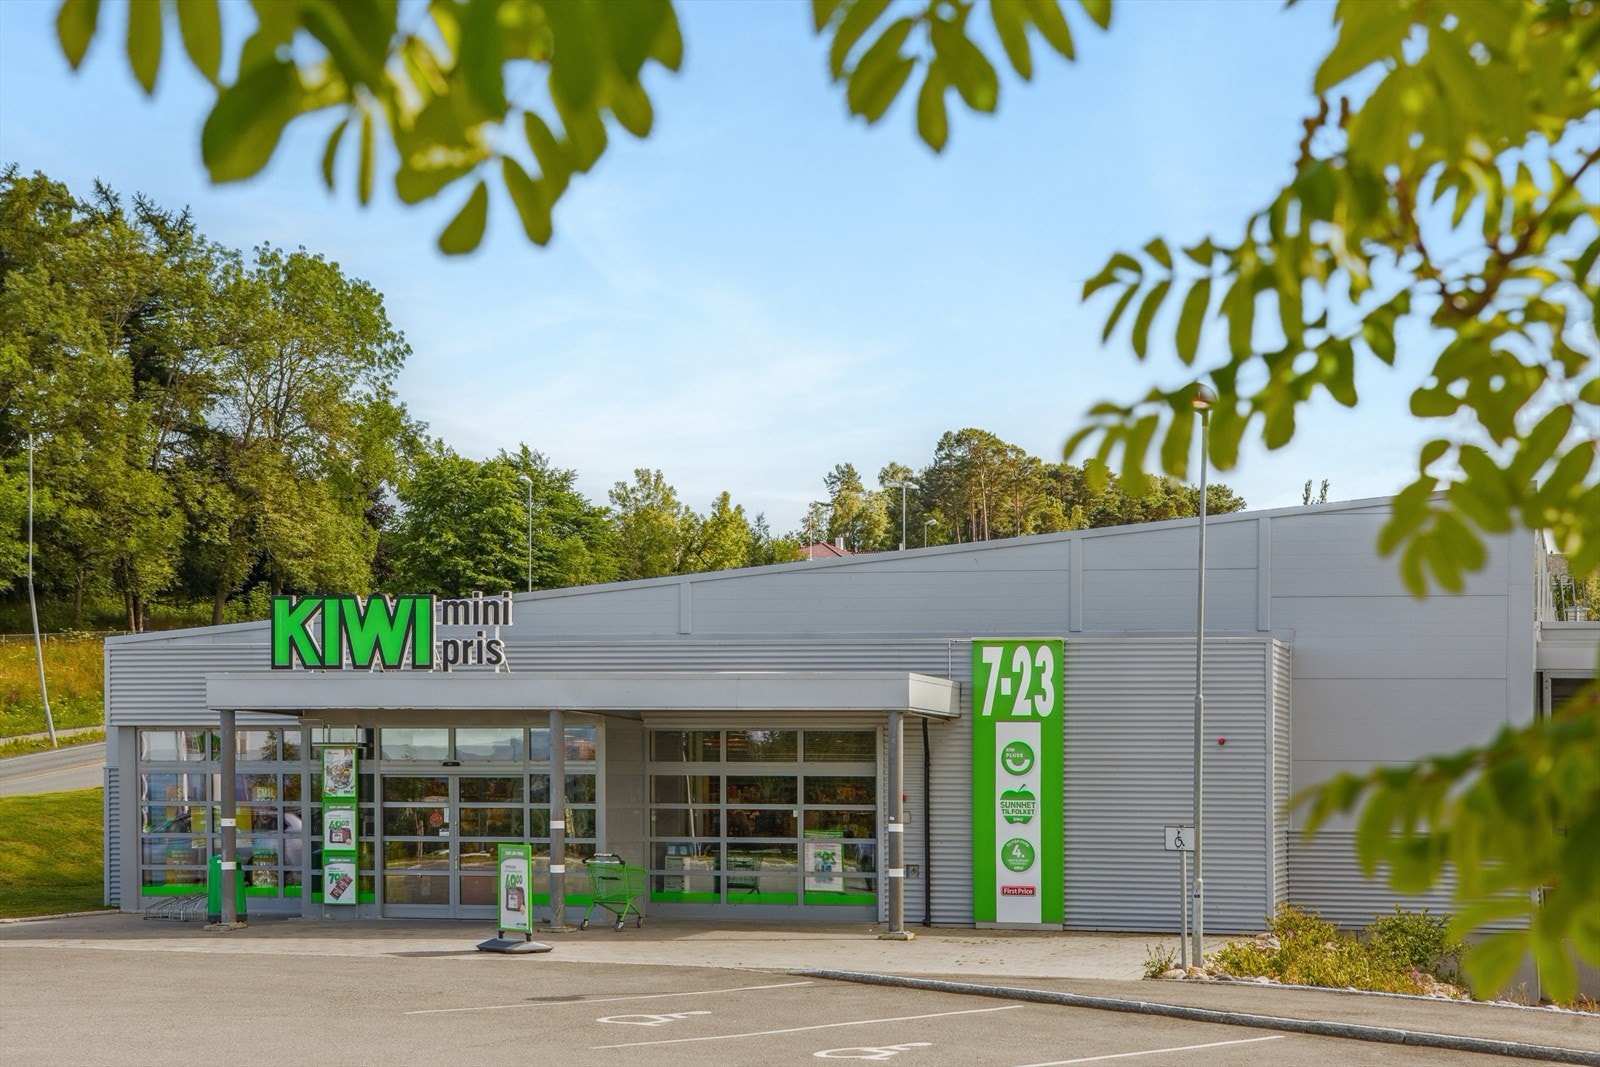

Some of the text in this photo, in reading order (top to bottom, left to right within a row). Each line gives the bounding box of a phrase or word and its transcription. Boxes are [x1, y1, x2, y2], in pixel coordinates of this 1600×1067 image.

[442, 591, 513, 625] mini
[271, 594, 434, 669] KIWI
[442, 630, 505, 671] pris
[982, 645, 1055, 717] 7-23
[1000, 801, 1036, 809] SUNNHET
